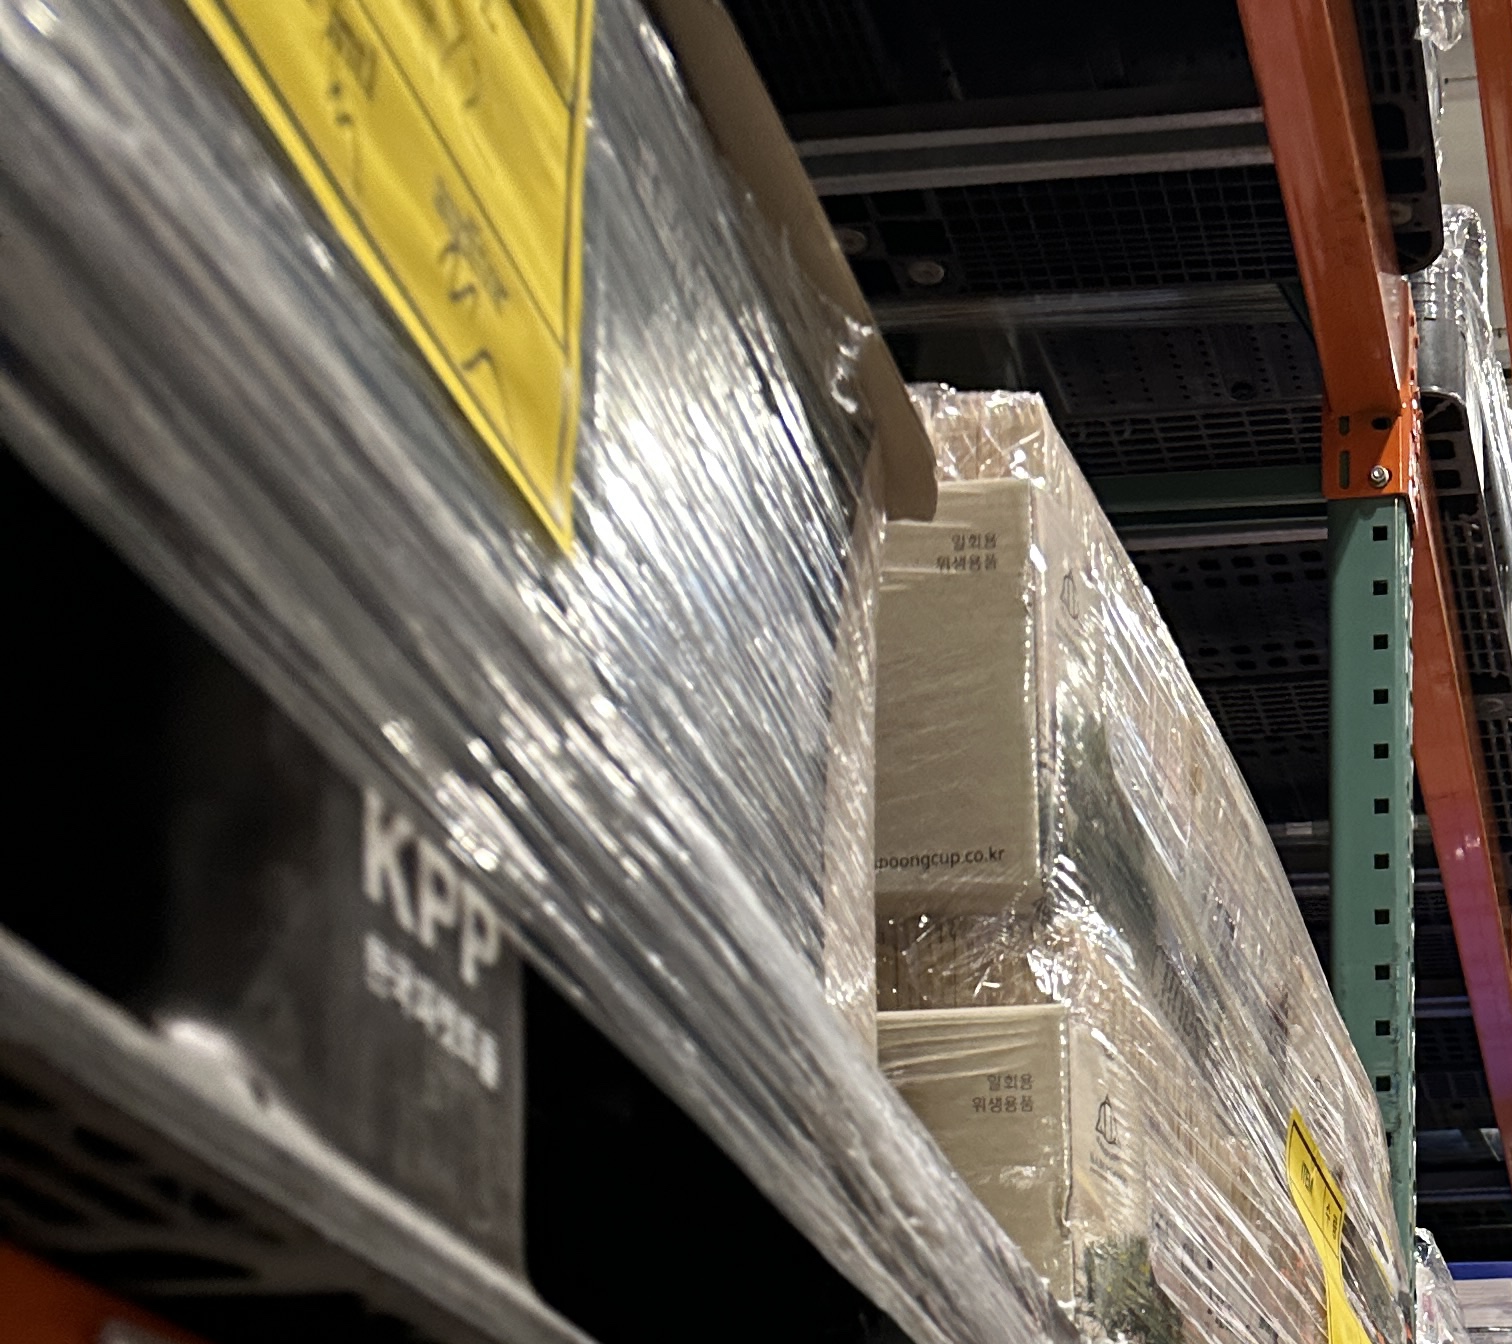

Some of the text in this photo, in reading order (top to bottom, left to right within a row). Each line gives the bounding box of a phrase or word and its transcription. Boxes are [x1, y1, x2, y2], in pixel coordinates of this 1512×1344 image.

[951, 532, 998, 551] 일회용
[935, 552, 998, 573] 위생용품
[362, 787, 499, 987] KPP
[986, 1073, 1034, 1091] 일회용
[971, 1095, 1034, 1113] 위생용품
